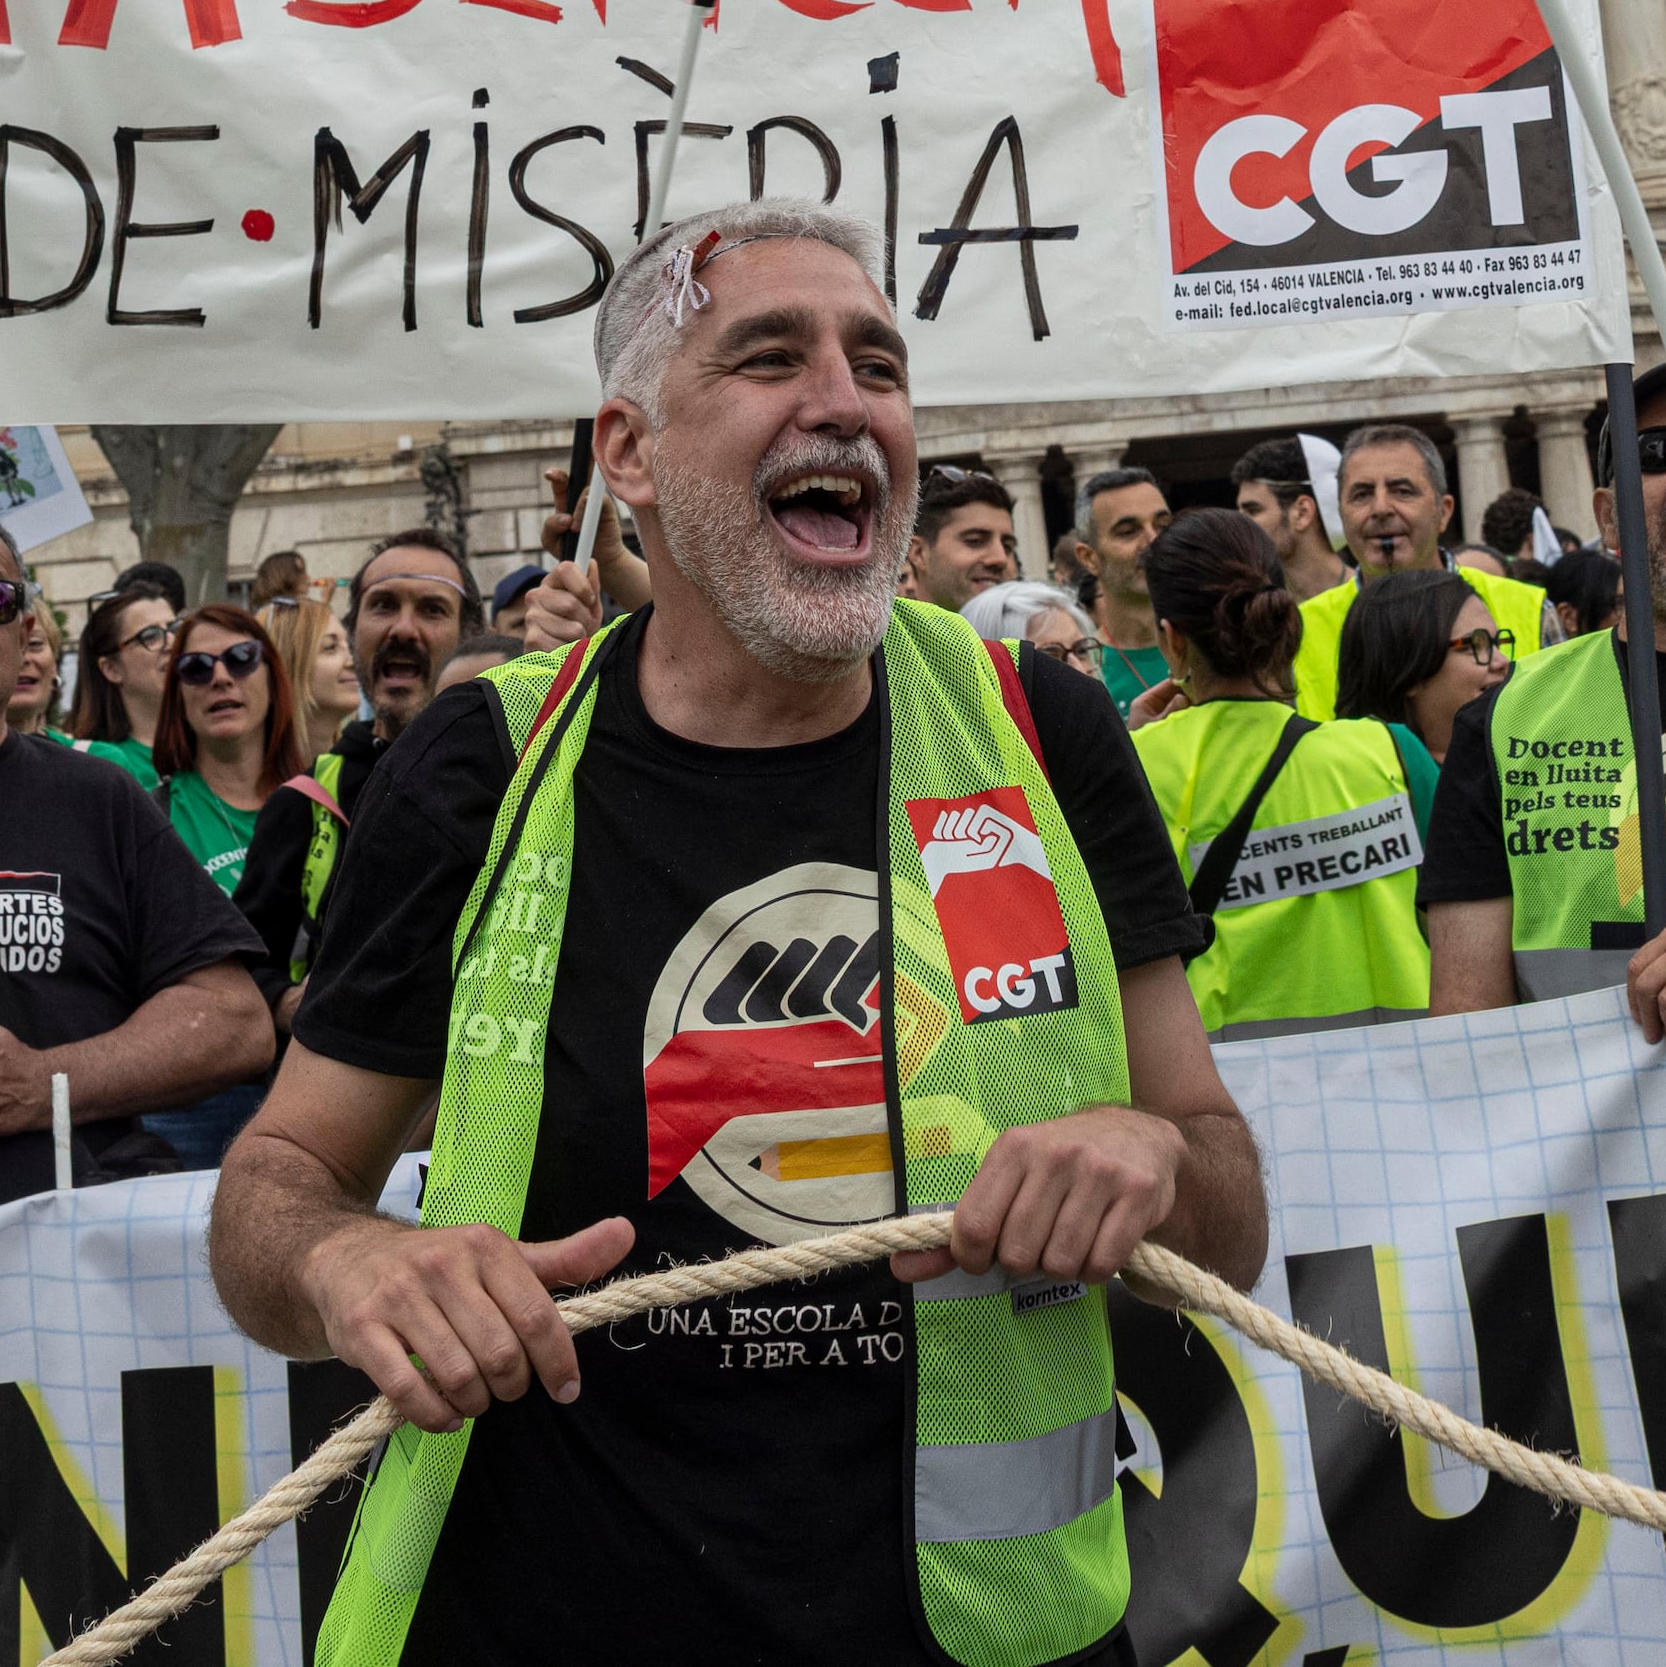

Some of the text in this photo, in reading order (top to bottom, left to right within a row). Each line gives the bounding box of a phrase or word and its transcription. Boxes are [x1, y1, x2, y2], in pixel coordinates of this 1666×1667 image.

[1193, 85, 1553, 247] CGT
[1174, 249, 1581, 298] Av. del Cid, 154 46014 VALENCIA Tel. 963 83 44 40 Fax 963 83 44 47
[1175, 275, 1585, 320] e-mail: fed.local@cgtvalencia.org www.cgtvalencia.org
[1507, 736, 1624, 759] Docent
[1505, 761, 1622, 786] en lluita
[1505, 790, 1622, 821] pels teus
[1238, 807, 1403, 861] CENTS TREBALLANT
[1507, 818, 1620, 857] drets
[1223, 833, 1411, 902] EN PRECARI
[964, 954, 1066, 1013] CGT
[1017, 1282, 1082, 1311] korntex
[647, 1306, 715, 1336] UNA
[730, 1301, 869, 1336] ESCOLA
[744, 1340, 811, 1368] PER
[820, 1337, 847, 1365] A
